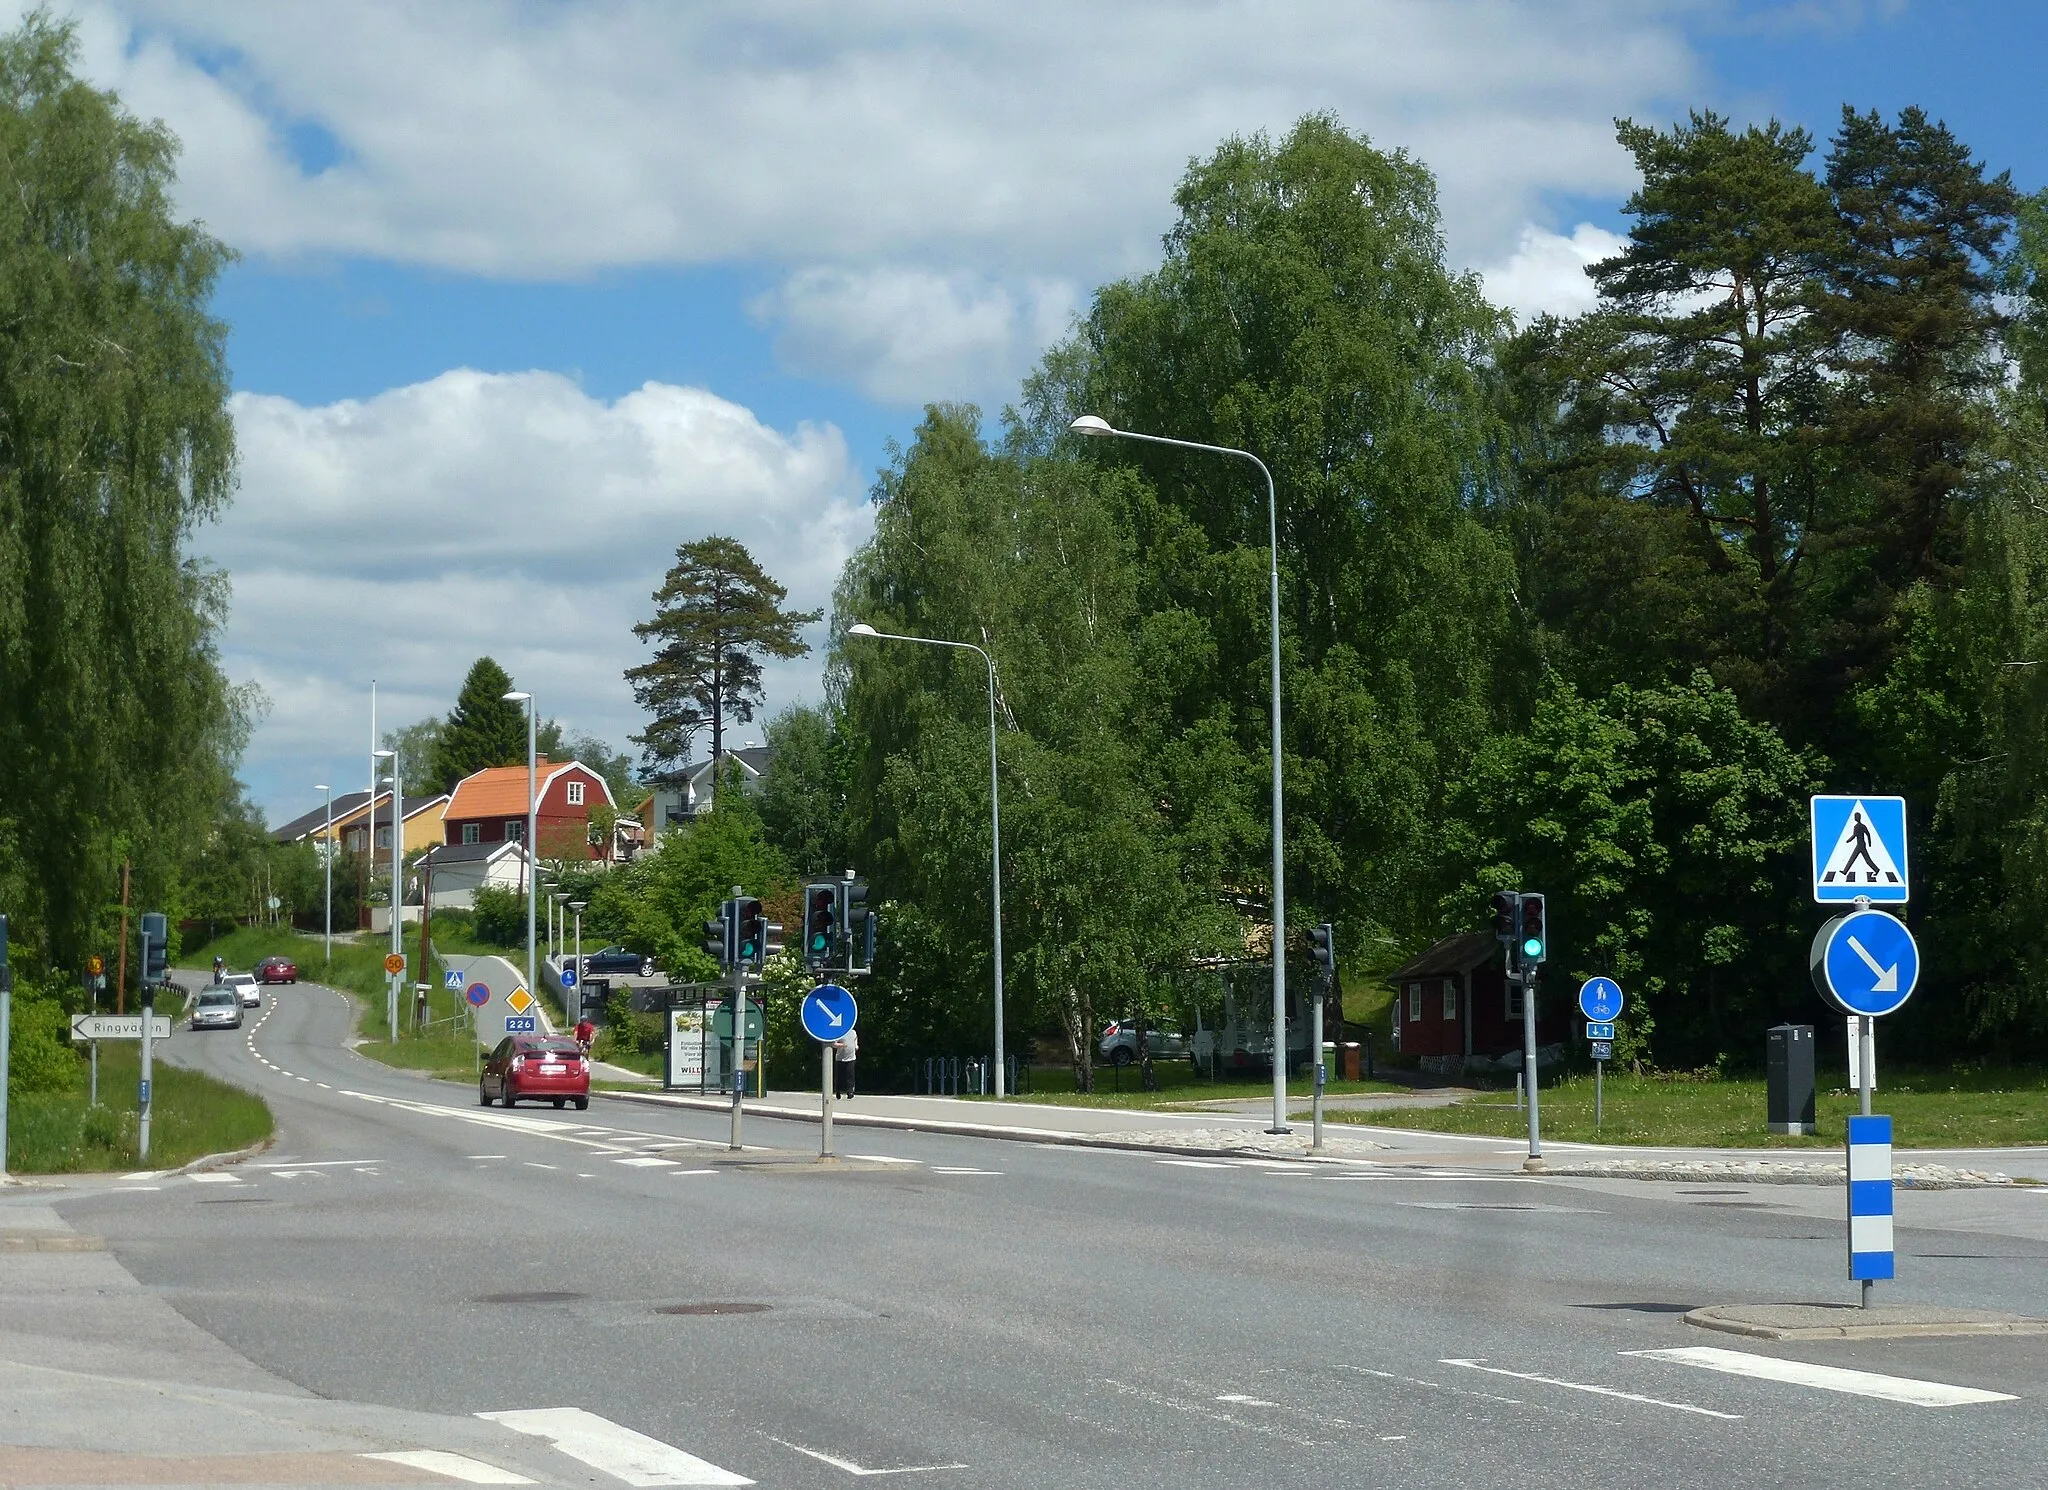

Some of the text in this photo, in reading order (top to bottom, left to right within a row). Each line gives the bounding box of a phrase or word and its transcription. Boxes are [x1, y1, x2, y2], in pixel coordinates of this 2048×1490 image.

[388, 959, 402, 969] 50
[94, 1022, 162, 1034] Ringvägn
[509, 1020, 531, 1029] 226
